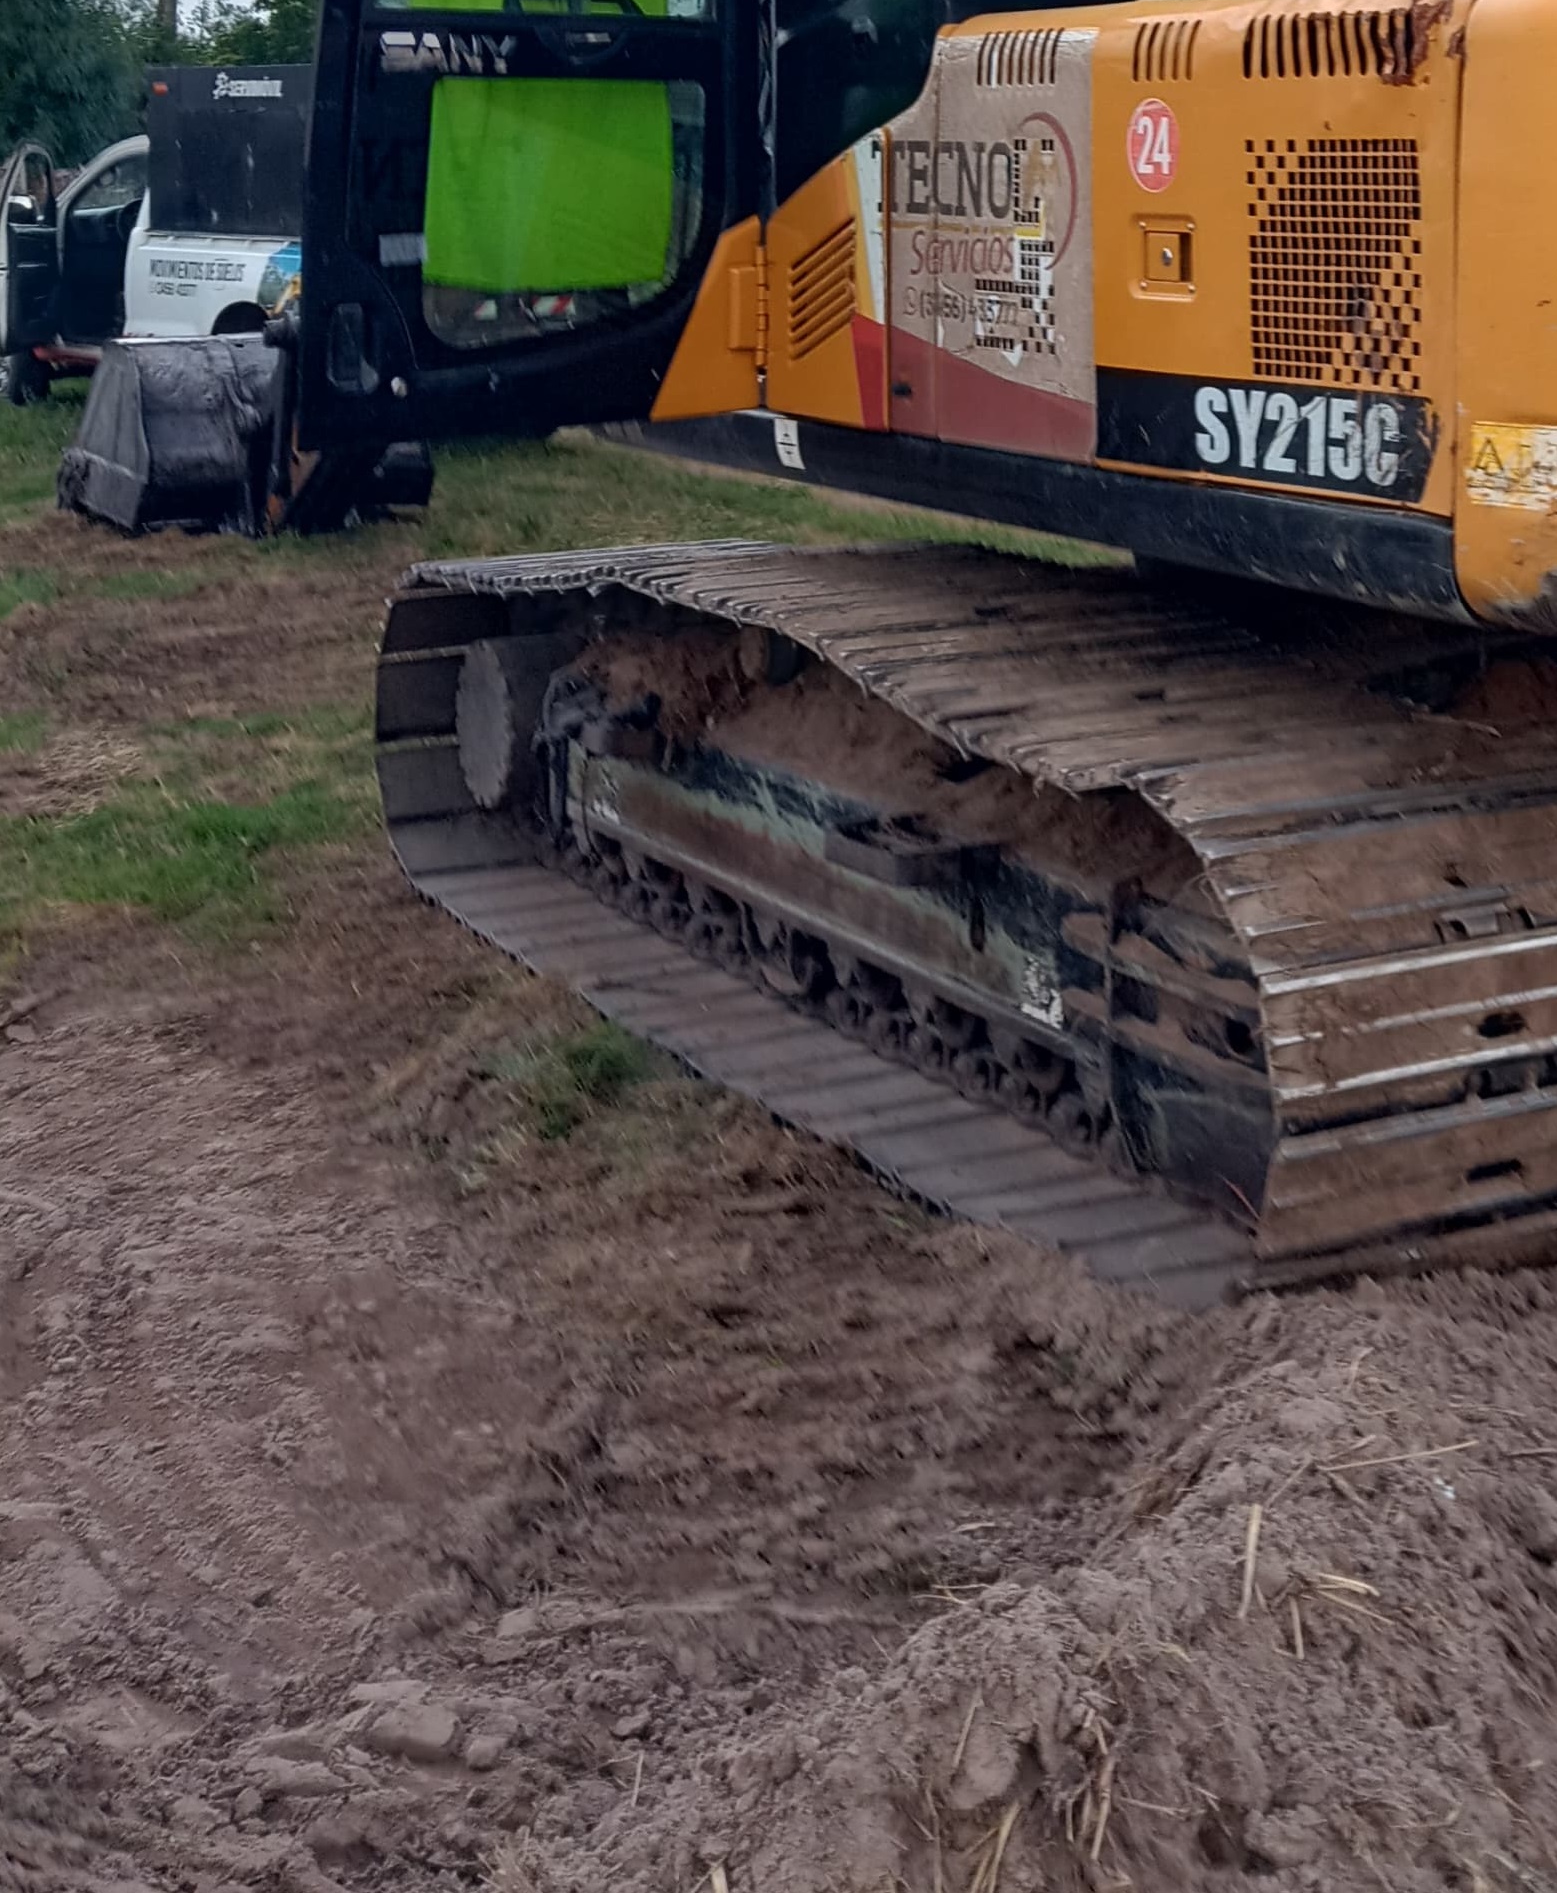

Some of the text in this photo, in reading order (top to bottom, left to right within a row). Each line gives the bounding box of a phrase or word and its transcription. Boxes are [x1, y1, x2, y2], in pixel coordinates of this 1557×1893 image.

[871, 139, 1012, 220] TECNO
[1136, 115, 1171, 175] 24
[909, 226, 1015, 276] Servicios
[1194, 386, 1400, 487] SY215C
